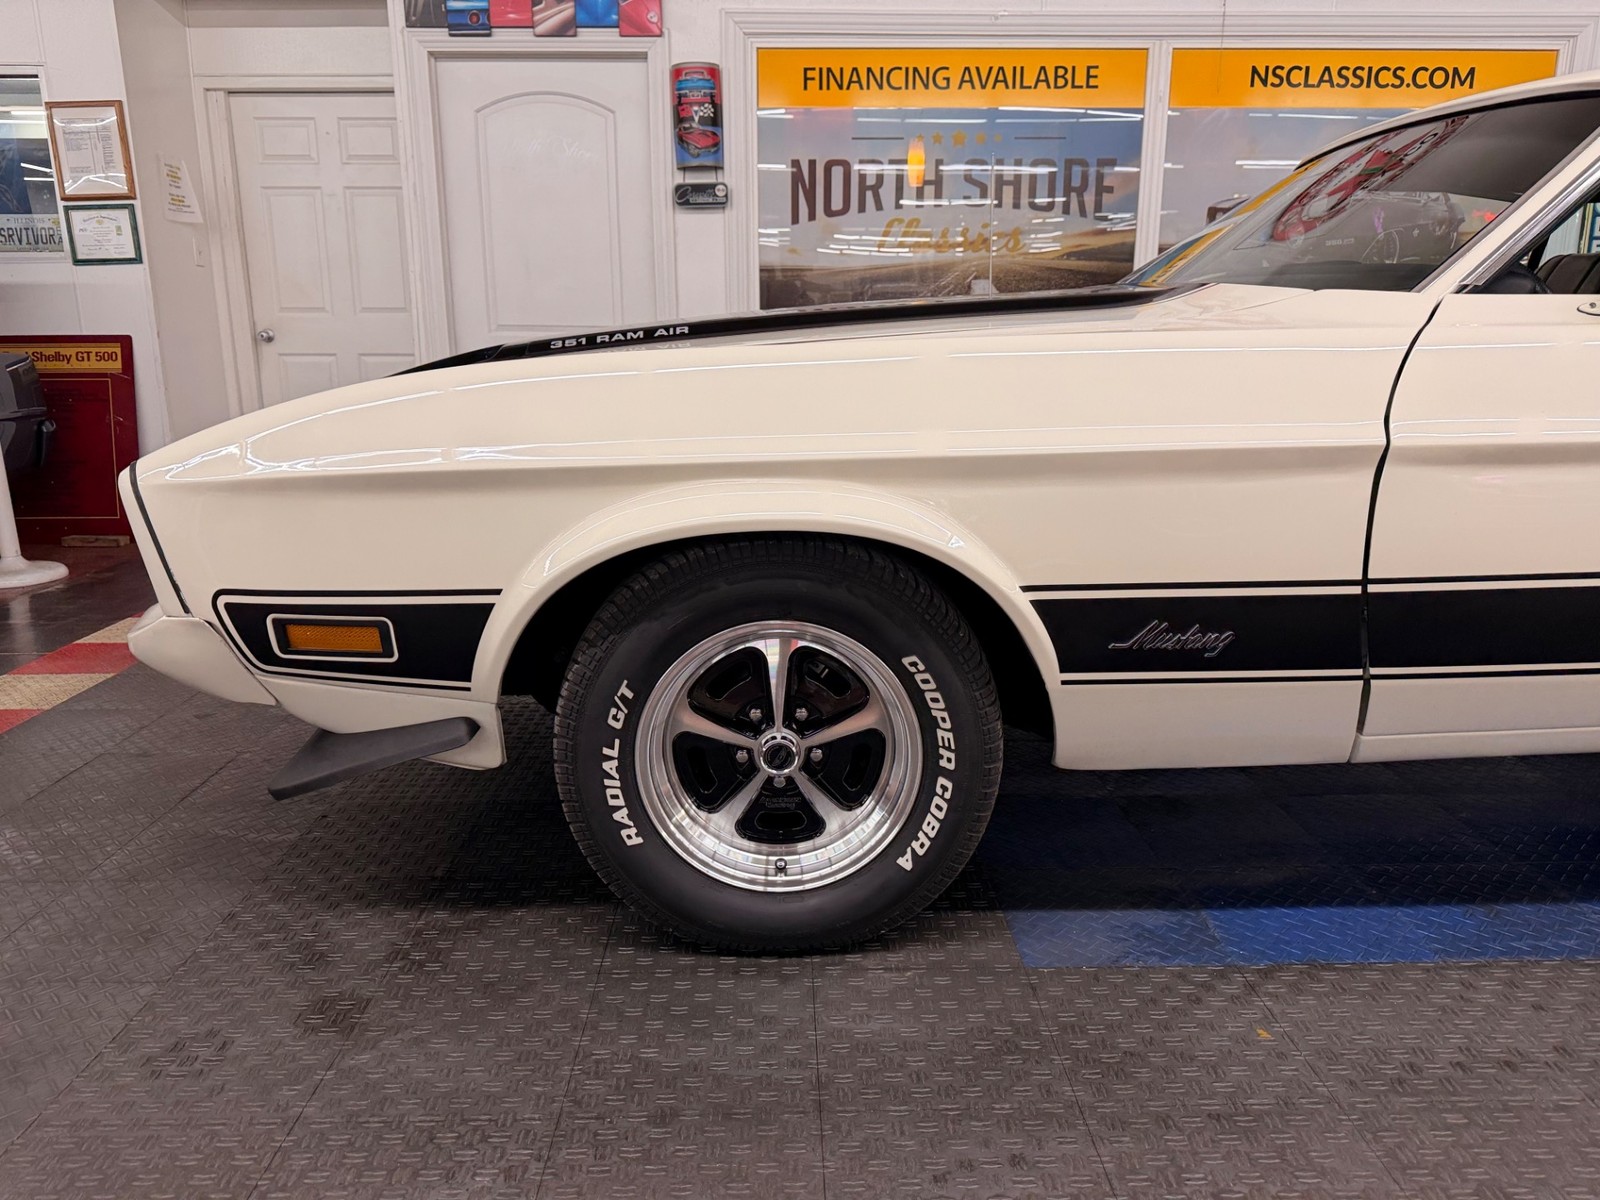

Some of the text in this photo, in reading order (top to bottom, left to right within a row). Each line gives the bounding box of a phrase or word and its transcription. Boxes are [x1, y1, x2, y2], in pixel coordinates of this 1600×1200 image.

[802, 65, 1100, 91] FINANCING AVAILABLE
[1249, 64, 1477, 90] NSCLASSICS.COM
[791, 158, 1118, 226] NORTH SHORE
[550, 326, 689, 349] 351 RAM AIR
[31, 351, 72, 364] Shelby
[75, 351, 93, 362] GT
[95, 351, 118, 362] 500
[1108, 619, 1236, 657] Mustang
[602, 679, 644, 846] RADIAL G/T
[896, 655, 956, 871] COOPER COBRA
